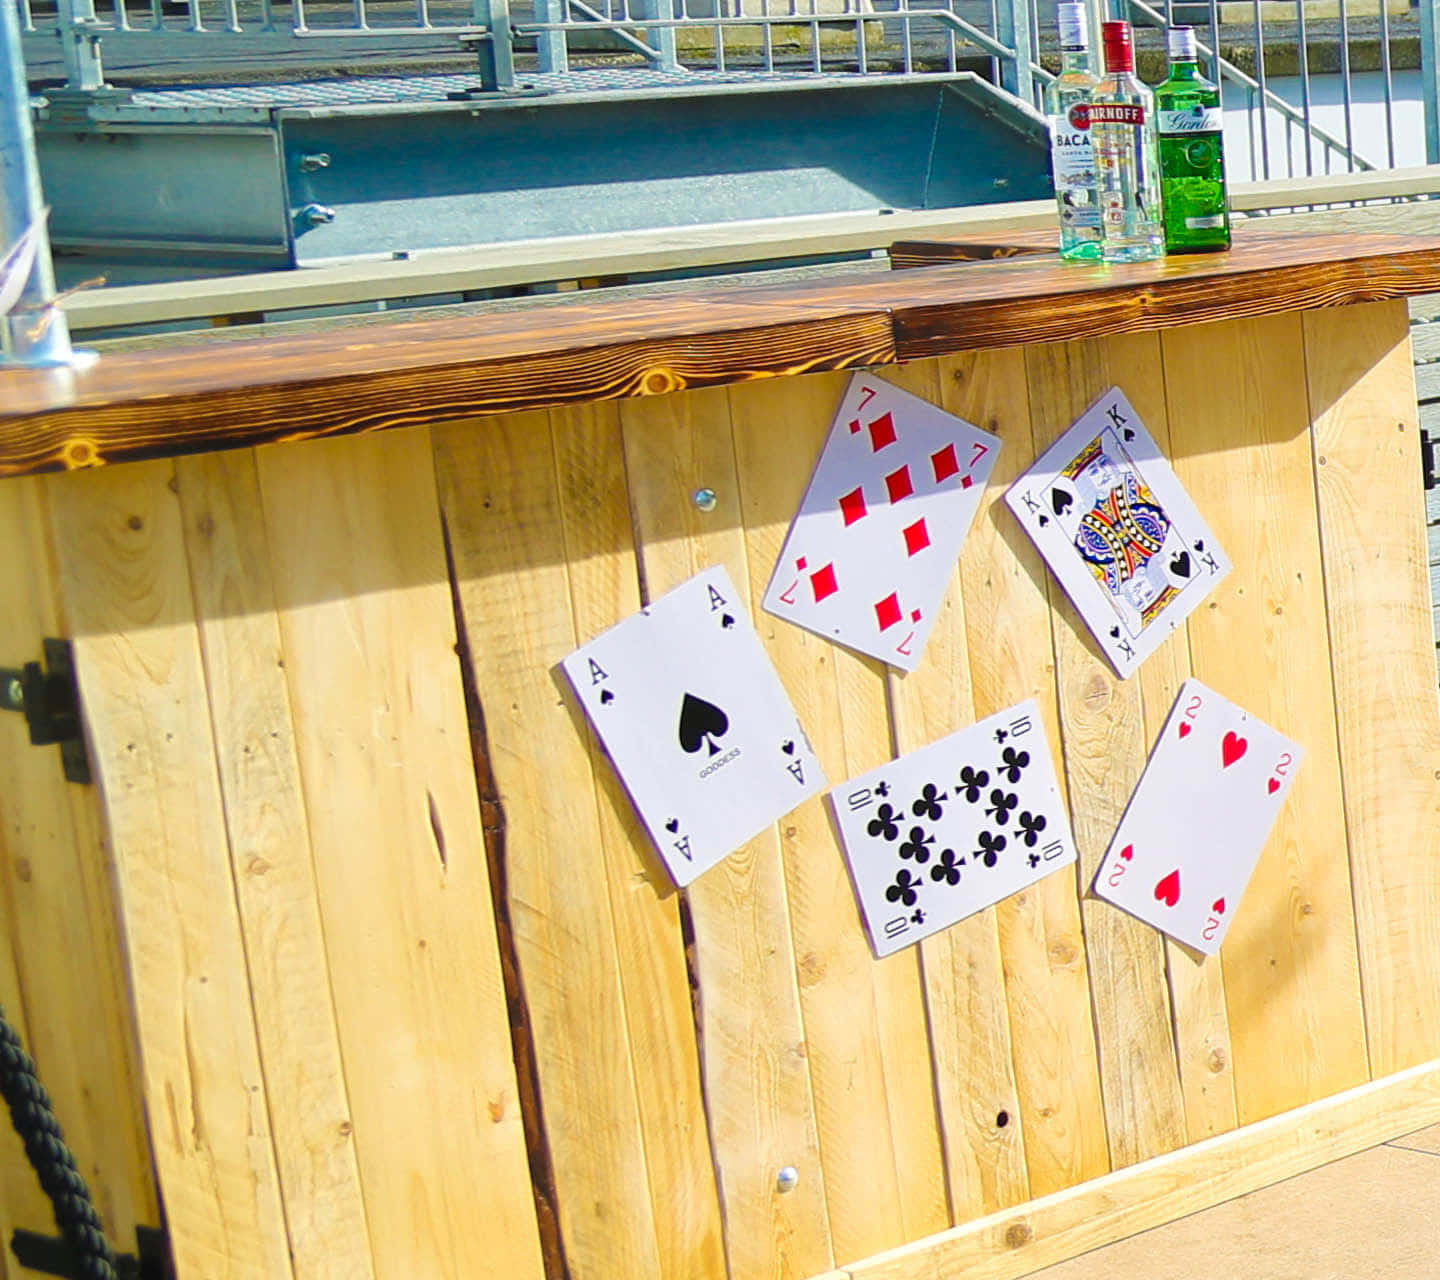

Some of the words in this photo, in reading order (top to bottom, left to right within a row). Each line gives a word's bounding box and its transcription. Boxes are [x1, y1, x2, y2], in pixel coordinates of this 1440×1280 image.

[1089, 106, 1139, 121] IRNOFF
[1057, 134, 1092, 147] BACA
[858, 387, 876, 411] 7
[1106, 403, 1128, 429] K
[970, 443, 988, 467] 7
[1020, 489, 1041, 515] K
[1200, 551, 1220, 576] K
[708, 584, 728, 612] A
[780, 580, 798, 604] 7
[896, 632, 914, 656] 7
[1116, 637, 1137, 663] K
[588, 658, 609, 686] A
[1185, 695, 1202, 720] 2
[1009, 715, 1032, 737] 10
[700, 748, 741, 779] GODDESS
[787, 759, 805, 786] A
[1276, 752, 1292, 777] 2
[848, 788, 873, 811] 10
[674, 835, 692, 862] A
[1040, 839, 1064, 861] 10
[1108, 863, 1126, 888] 2
[884, 916, 910, 939] 10
[1202, 917, 1220, 941] 2
